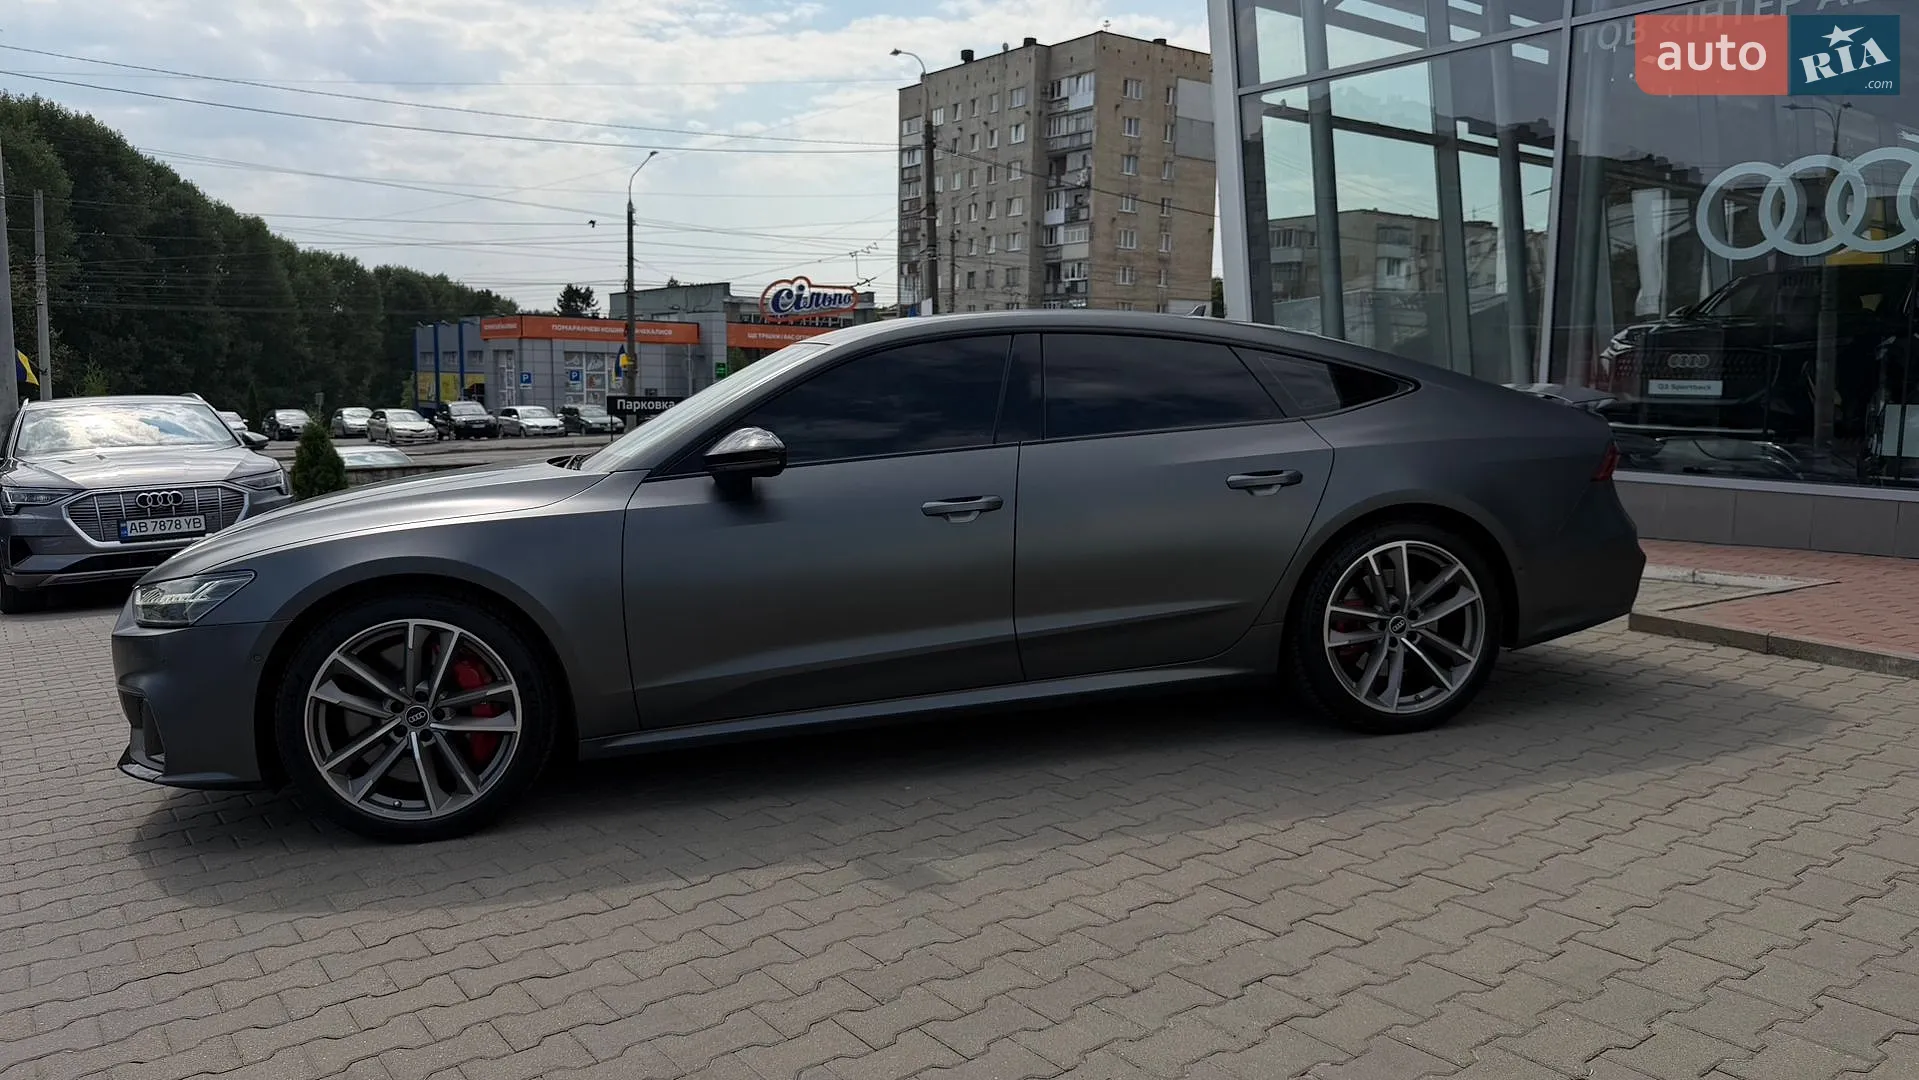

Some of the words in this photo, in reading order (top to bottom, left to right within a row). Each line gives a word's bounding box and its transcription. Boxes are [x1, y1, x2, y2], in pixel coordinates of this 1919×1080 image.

[771, 284, 853, 314] Сільпо
[617, 399, 675, 413] Парковка
[129, 522, 149, 533] AB
[151, 519, 182, 532] 7878
[184, 517, 202, 529] YB
